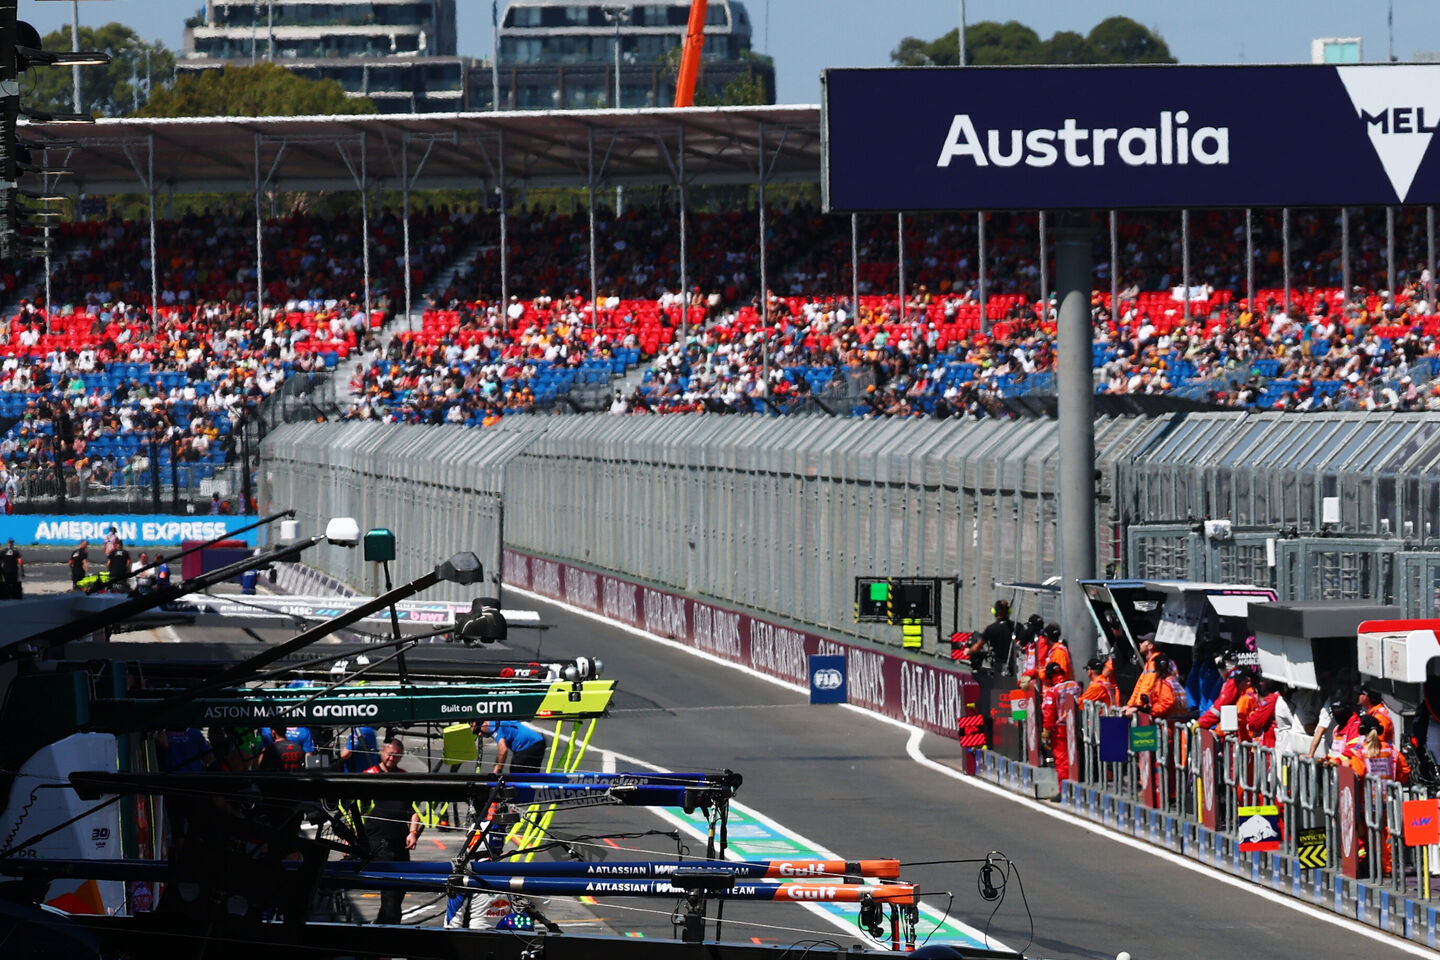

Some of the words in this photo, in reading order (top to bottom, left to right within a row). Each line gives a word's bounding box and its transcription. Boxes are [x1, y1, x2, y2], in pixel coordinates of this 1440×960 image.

[1360, 107, 1438, 135] MEL
[937, 110, 1229, 168] Australia
[35, 521, 137, 540] AMERICAN
[142, 522, 227, 540] EXPRESS
[814, 672, 840, 687] FIA
[900, 660, 936, 724] QATAR
[205, 706, 249, 718] ASTON
[253, 705, 306, 719] MARTIN
[312, 702, 379, 718] aramco
[441, 703, 457, 714] Built
[457, 705, 473, 713] on
[476, 700, 513, 714] arm
[595, 866, 647, 875] ATLASSIAN
[779, 862, 825, 876] Gulf
[595, 883, 649, 892] ATLASSIAN
[787, 885, 837, 899] Gulf
